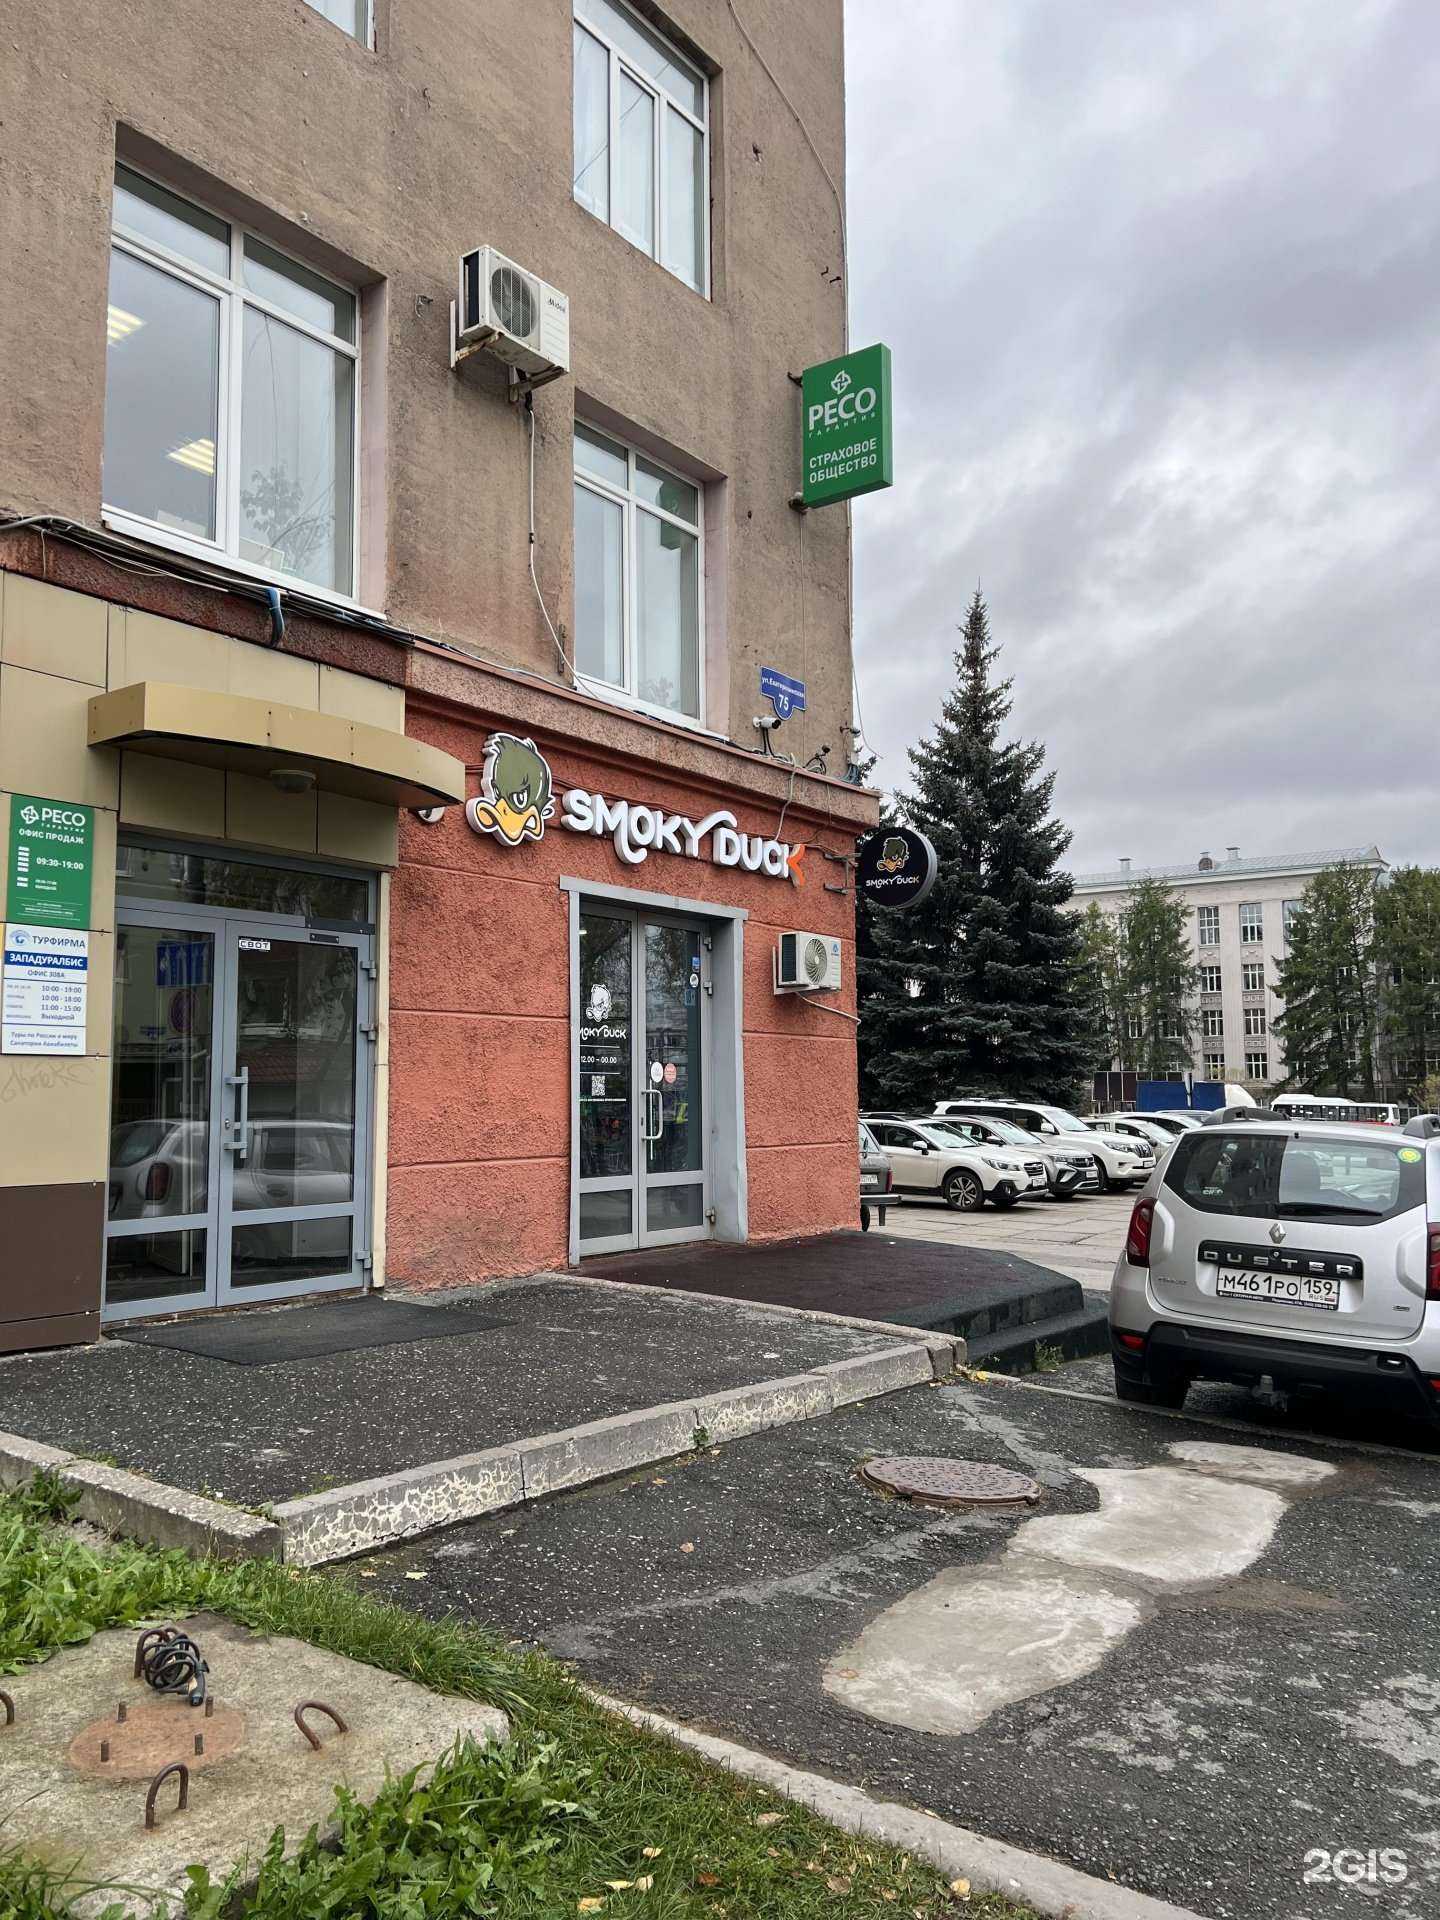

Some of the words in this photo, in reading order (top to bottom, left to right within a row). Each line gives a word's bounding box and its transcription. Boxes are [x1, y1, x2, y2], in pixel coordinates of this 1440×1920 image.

[808, 387, 877, 431] РЕСО
[809, 437, 878, 469] СТРАХОВОЕ
[809, 453, 877, 484] ОБЩЕСТВО
[778, 693, 789, 711] 75
[41, 807, 86, 827] РЕСО
[19, 828, 44, 839] ОФИС
[45, 832, 84, 845] ПРОДАЖ
[560, 788, 738, 864] SMOKY
[712, 825, 806, 888] DUCK
[36, 857, 84, 871] 09:30-19:00
[865, 875, 902, 889] SMOKY
[896, 875, 920, 885] DUCK
[32, 935, 86, 949] ТУРФИРМА
[9, 953, 84, 967] ЗАПАДУРАЛБИС
[27, 969, 48, 978] ОФИС
[603, 1027, 627, 1040] DUCK
[1203, 1250, 1354, 1275] DUSTER
[1223, 1273, 1299, 1297] М461РО
[1303, 1279, 1334, 1296] 159
[1309, 1293, 1325, 1301] RUS
